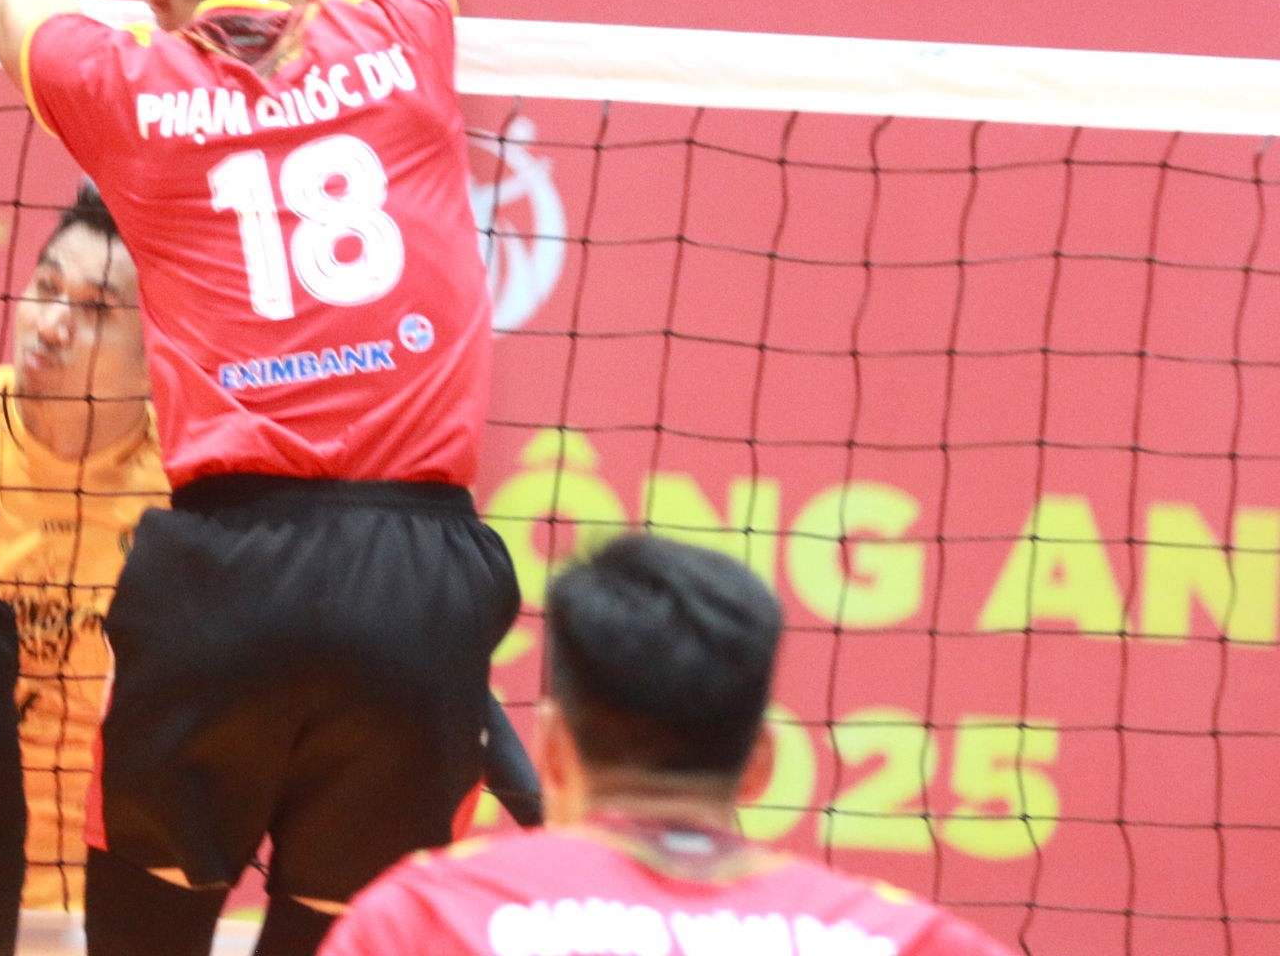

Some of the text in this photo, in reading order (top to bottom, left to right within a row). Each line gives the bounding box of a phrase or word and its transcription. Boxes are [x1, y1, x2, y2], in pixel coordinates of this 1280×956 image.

[136, 86, 253, 145] PHẠM
[207, 133, 406, 321] 18
[219, 339, 397, 390] EXIMBANK
[978, 493, 1279, 650] AN
[736, 702, 1062, 861] 025
